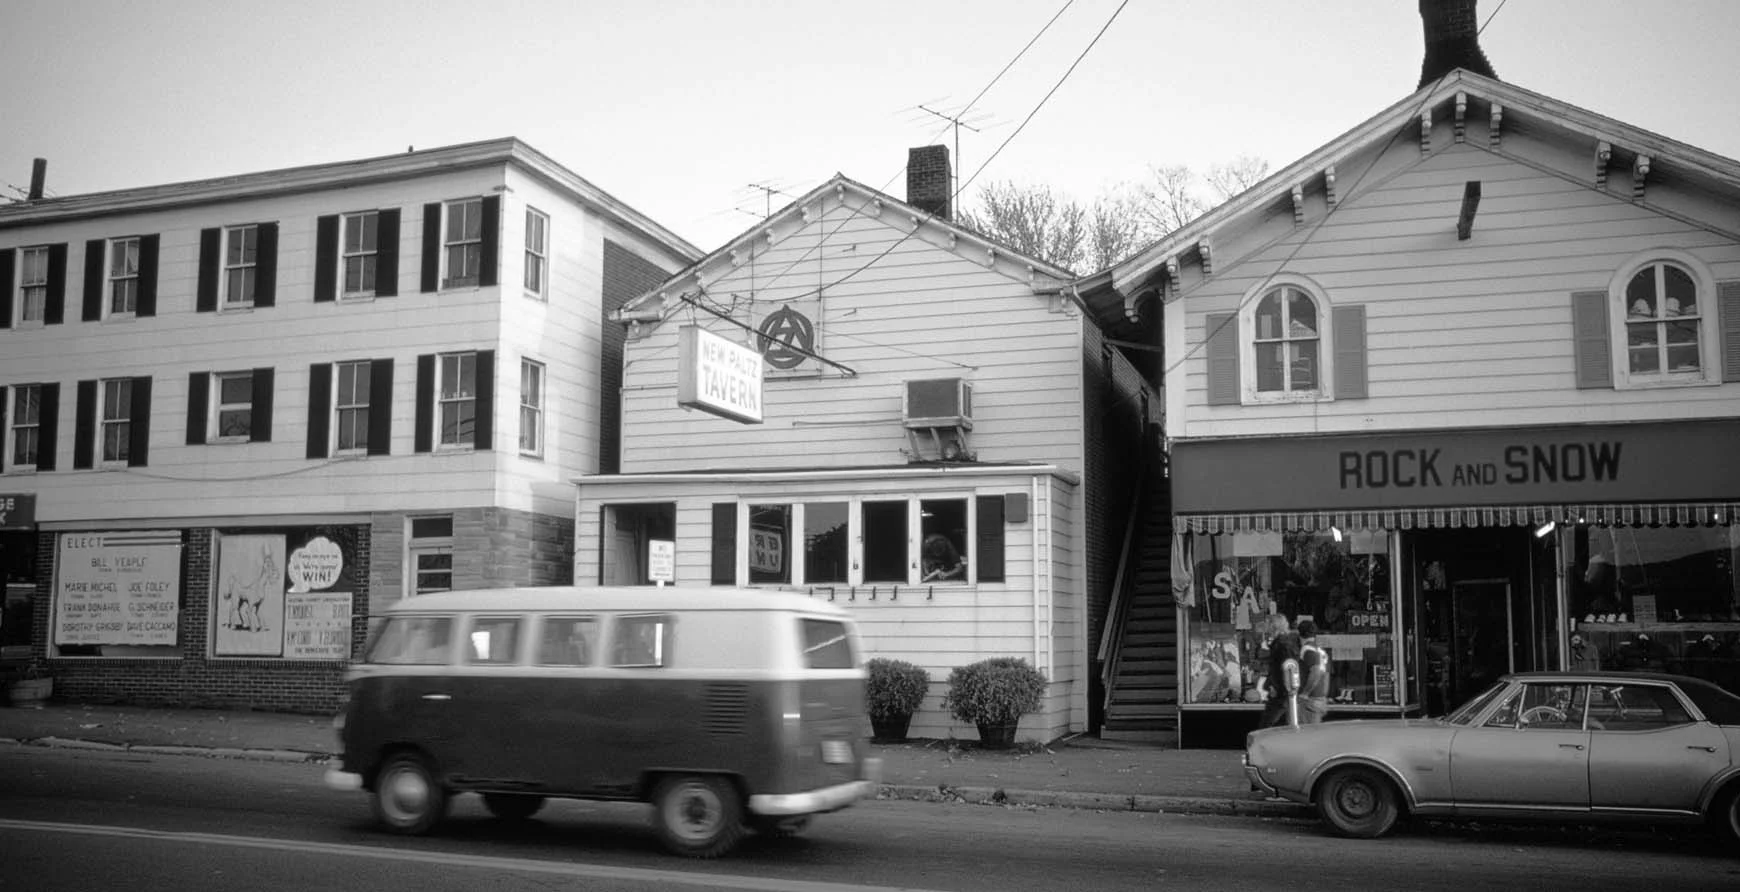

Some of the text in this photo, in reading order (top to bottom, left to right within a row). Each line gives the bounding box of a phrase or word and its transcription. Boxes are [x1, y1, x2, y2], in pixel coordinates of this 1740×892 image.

[703, 339, 758, 378] NEW PALTZ
[703, 363, 758, 412] TAVERN
[1339, 442, 1623, 490] ROCK AND SNOW
[67, 536, 102, 549] ELECT
[91, 557, 107, 568] BILL
[302, 571, 331, 582] WIN!
[145, 581, 170, 592] FOLEY
[1351, 614, 1389, 628] OPEN
